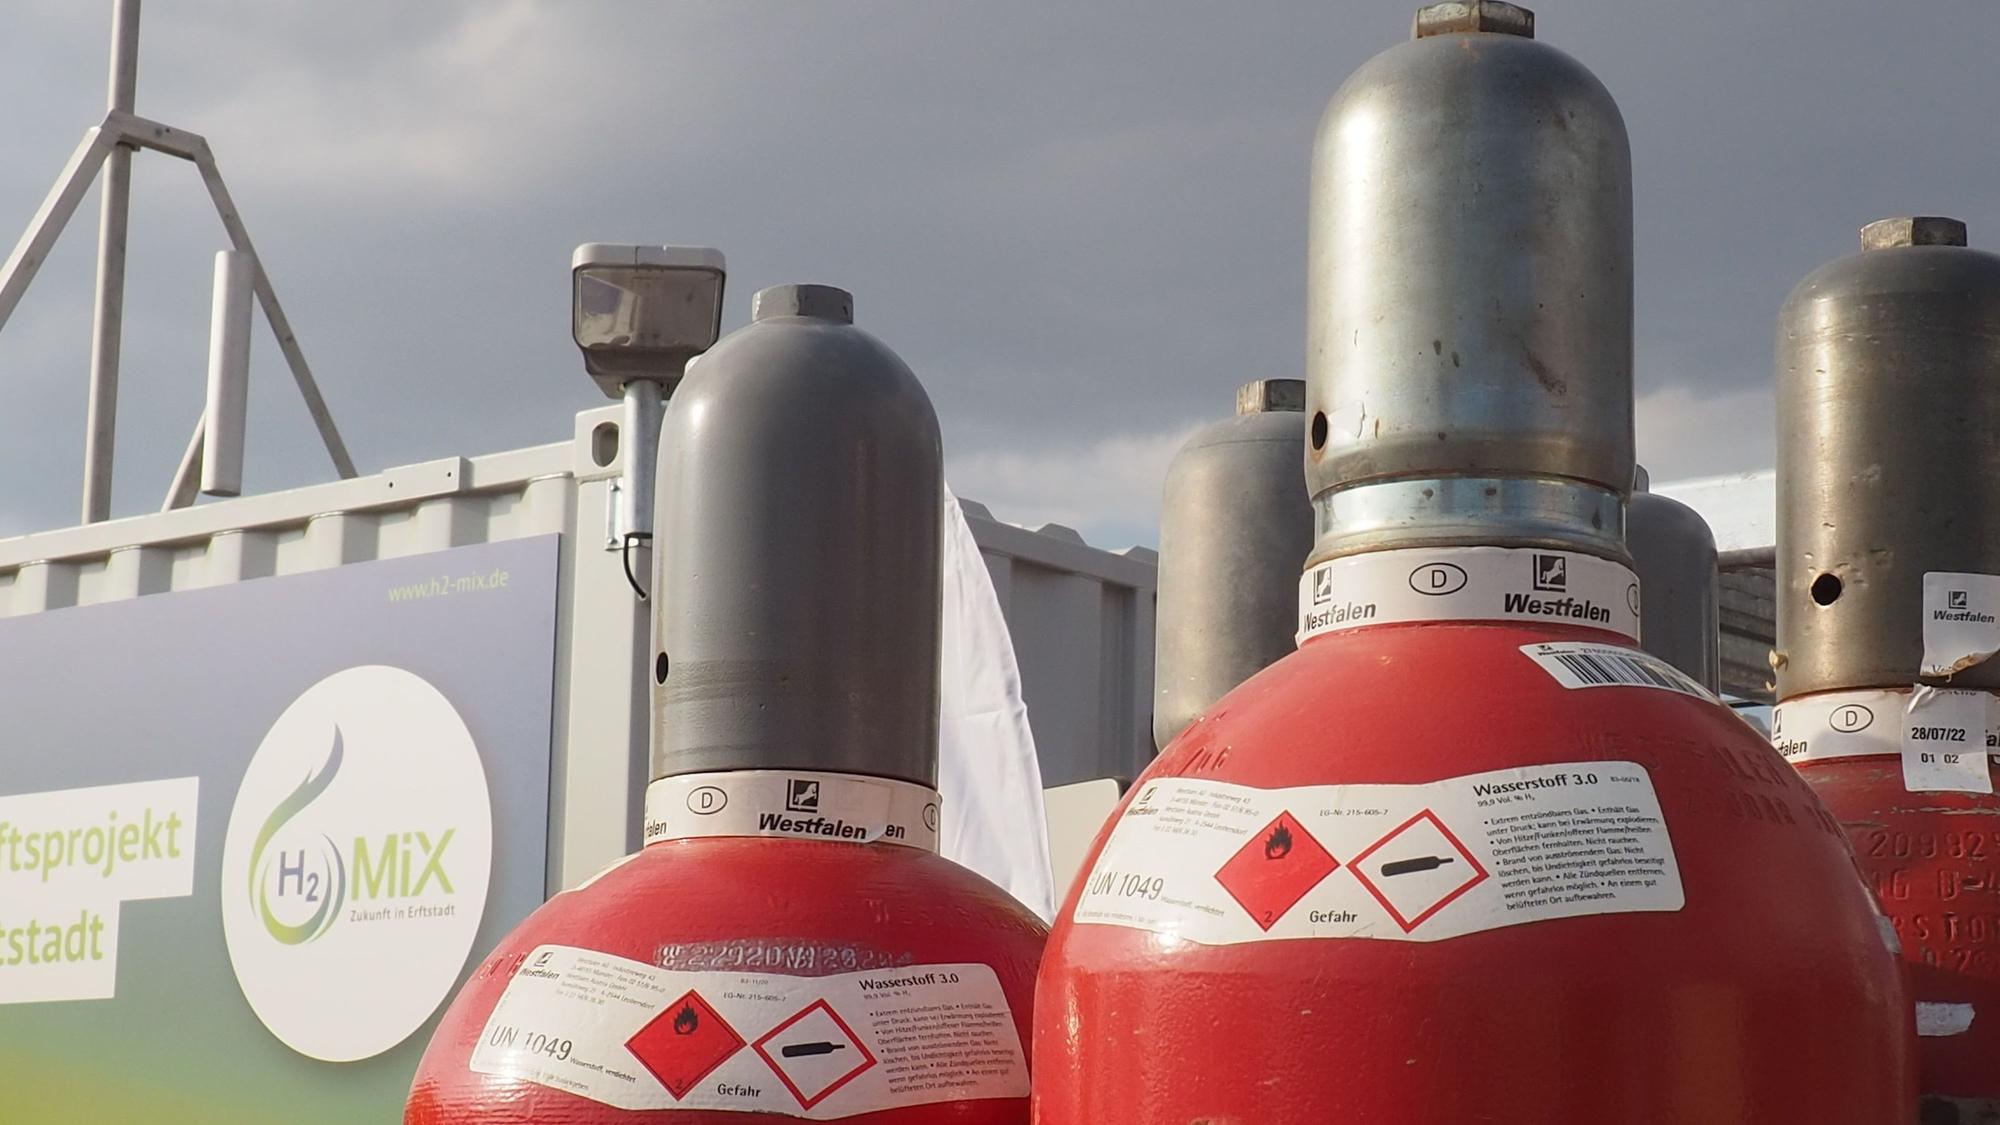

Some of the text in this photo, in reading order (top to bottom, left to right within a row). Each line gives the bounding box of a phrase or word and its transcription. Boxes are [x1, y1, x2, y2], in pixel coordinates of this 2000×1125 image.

[388, 567, 509, 603] www.h2-mix.de
[1430, 569, 1447, 589] D
[1303, 601, 1377, 633] Westfalen
[1504, 592, 1611, 624] Westfalen
[1933, 609, 1995, 624] Westfalen
[1845, 710, 1858, 727] D
[1911, 726, 1966, 742] 28/07/22
[1921, 752, 1960, 765] 01 02
[1473, 773, 1598, 797] Wasserstoff 3.0
[701, 791, 713, 809] D
[758, 813, 868, 840] Westfalen
[351, 828, 456, 901] MiX
[1502, 855, 1526, 866] Brand
[1092, 871, 1118, 896] UN
[1118, 873, 1164, 901] 1049
[350, 904, 456, 923] Zukunft in Erftstadt
[1263, 910, 1273, 923] 2
[1309, 909, 1358, 923] Gefahr
[858, 972, 960, 991] Wasserstoff 3.0
[490, 1025, 573, 1061] UN 1049
[675, 1078, 684, 1090] 2
[717, 1083, 762, 1098] Gefahr
